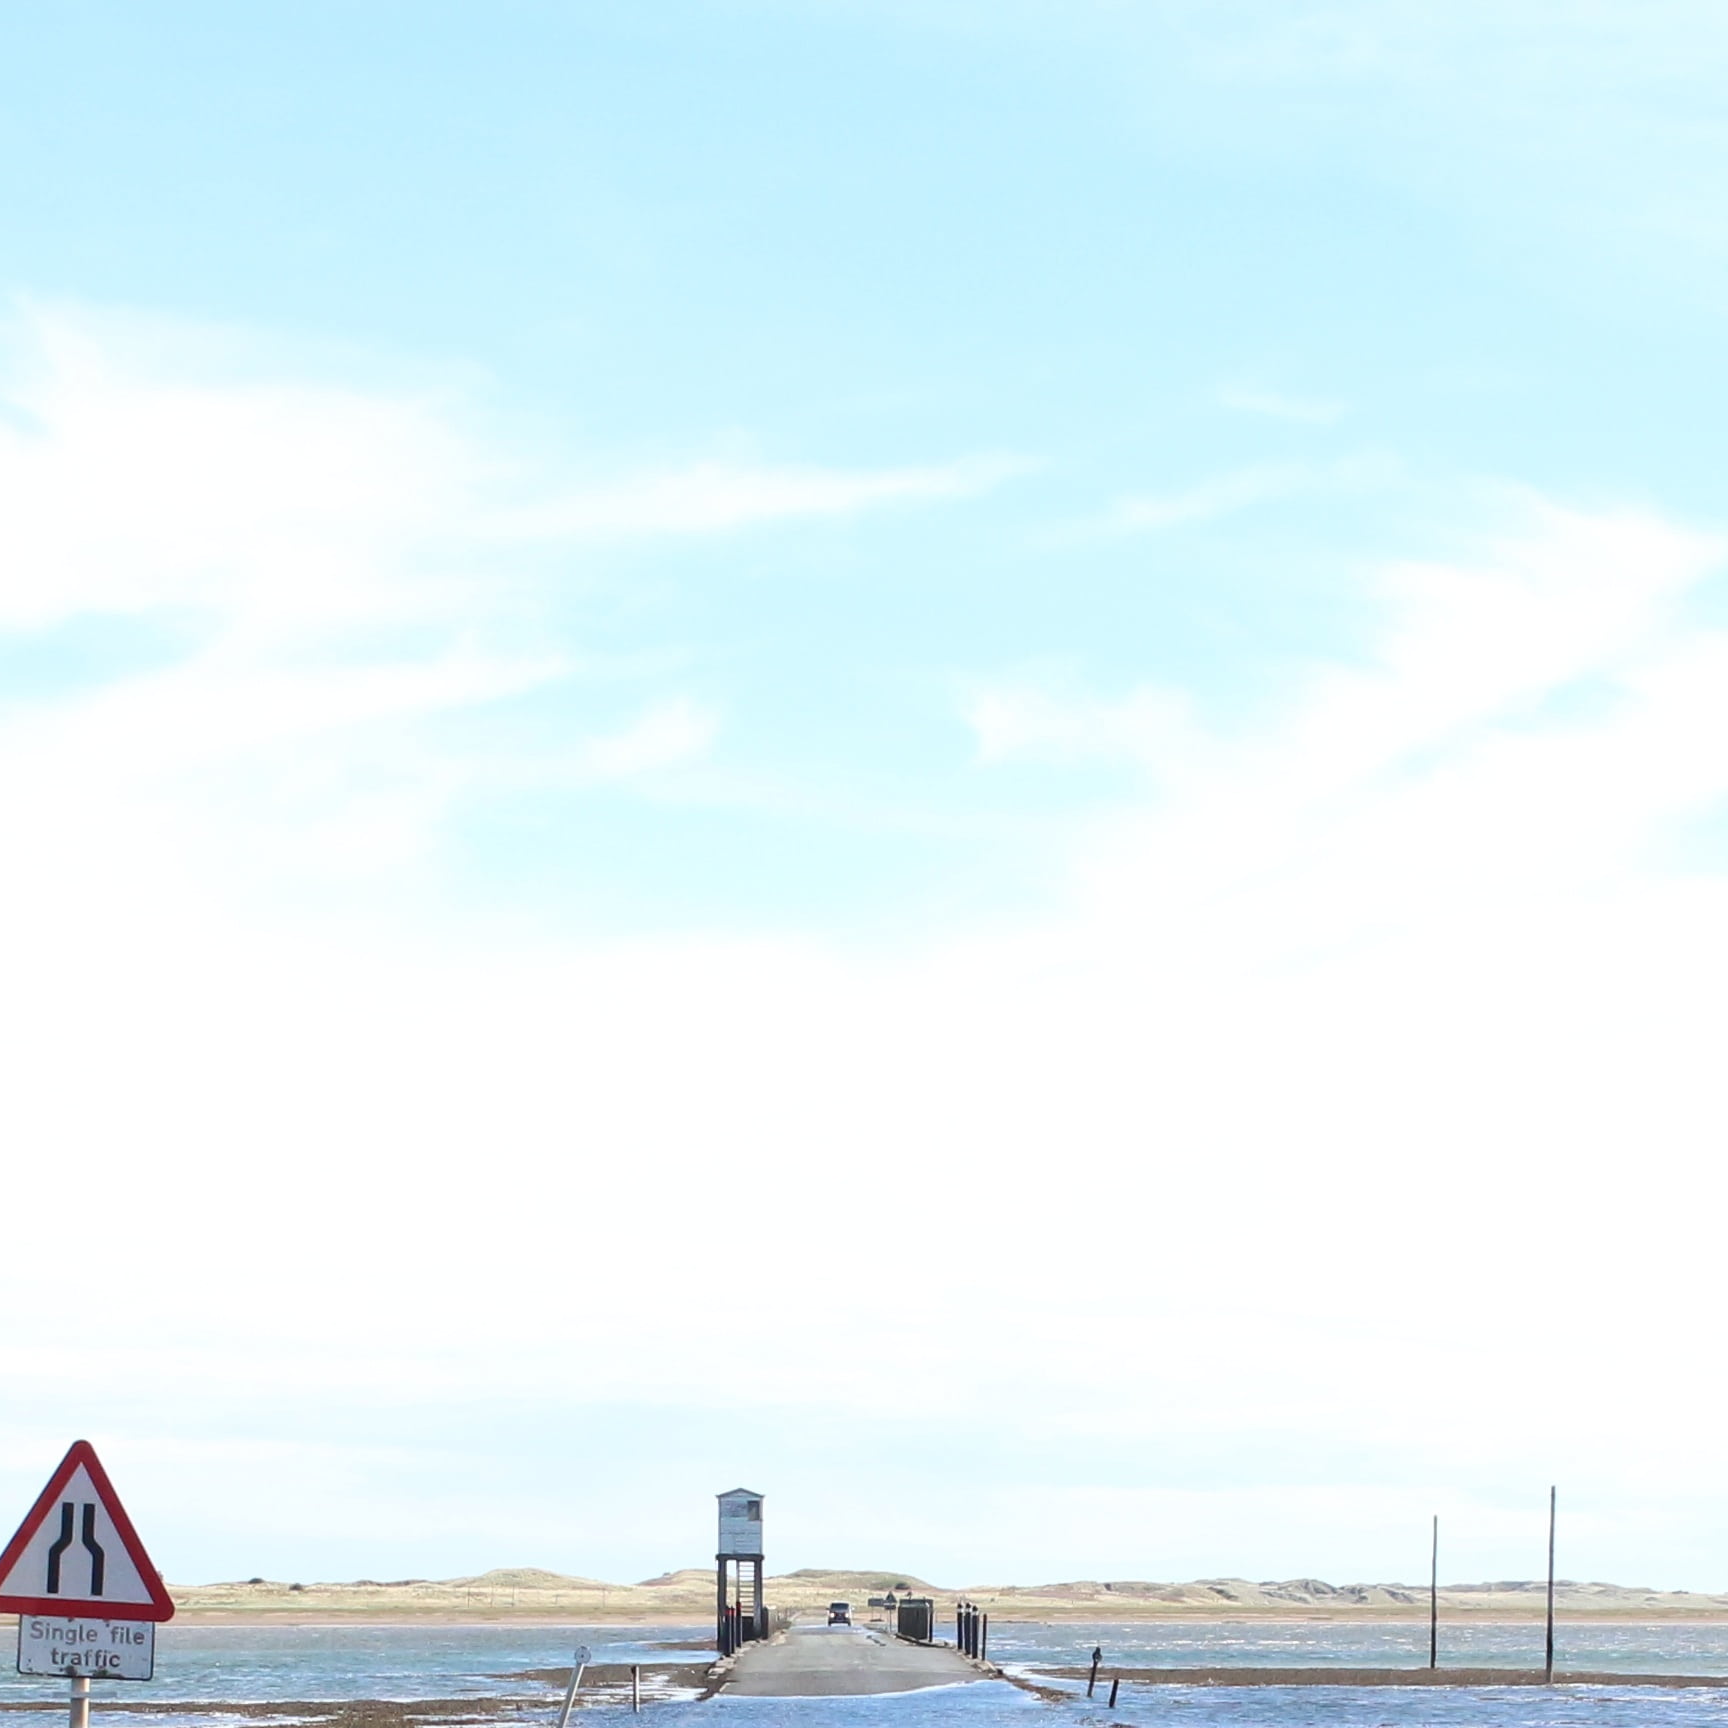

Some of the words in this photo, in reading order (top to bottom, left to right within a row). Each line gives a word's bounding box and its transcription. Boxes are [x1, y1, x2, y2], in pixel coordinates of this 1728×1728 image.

[30, 1620, 98, 1646] Single
[110, 1625, 146, 1646] file
[50, 1647, 121, 1668] traffic
